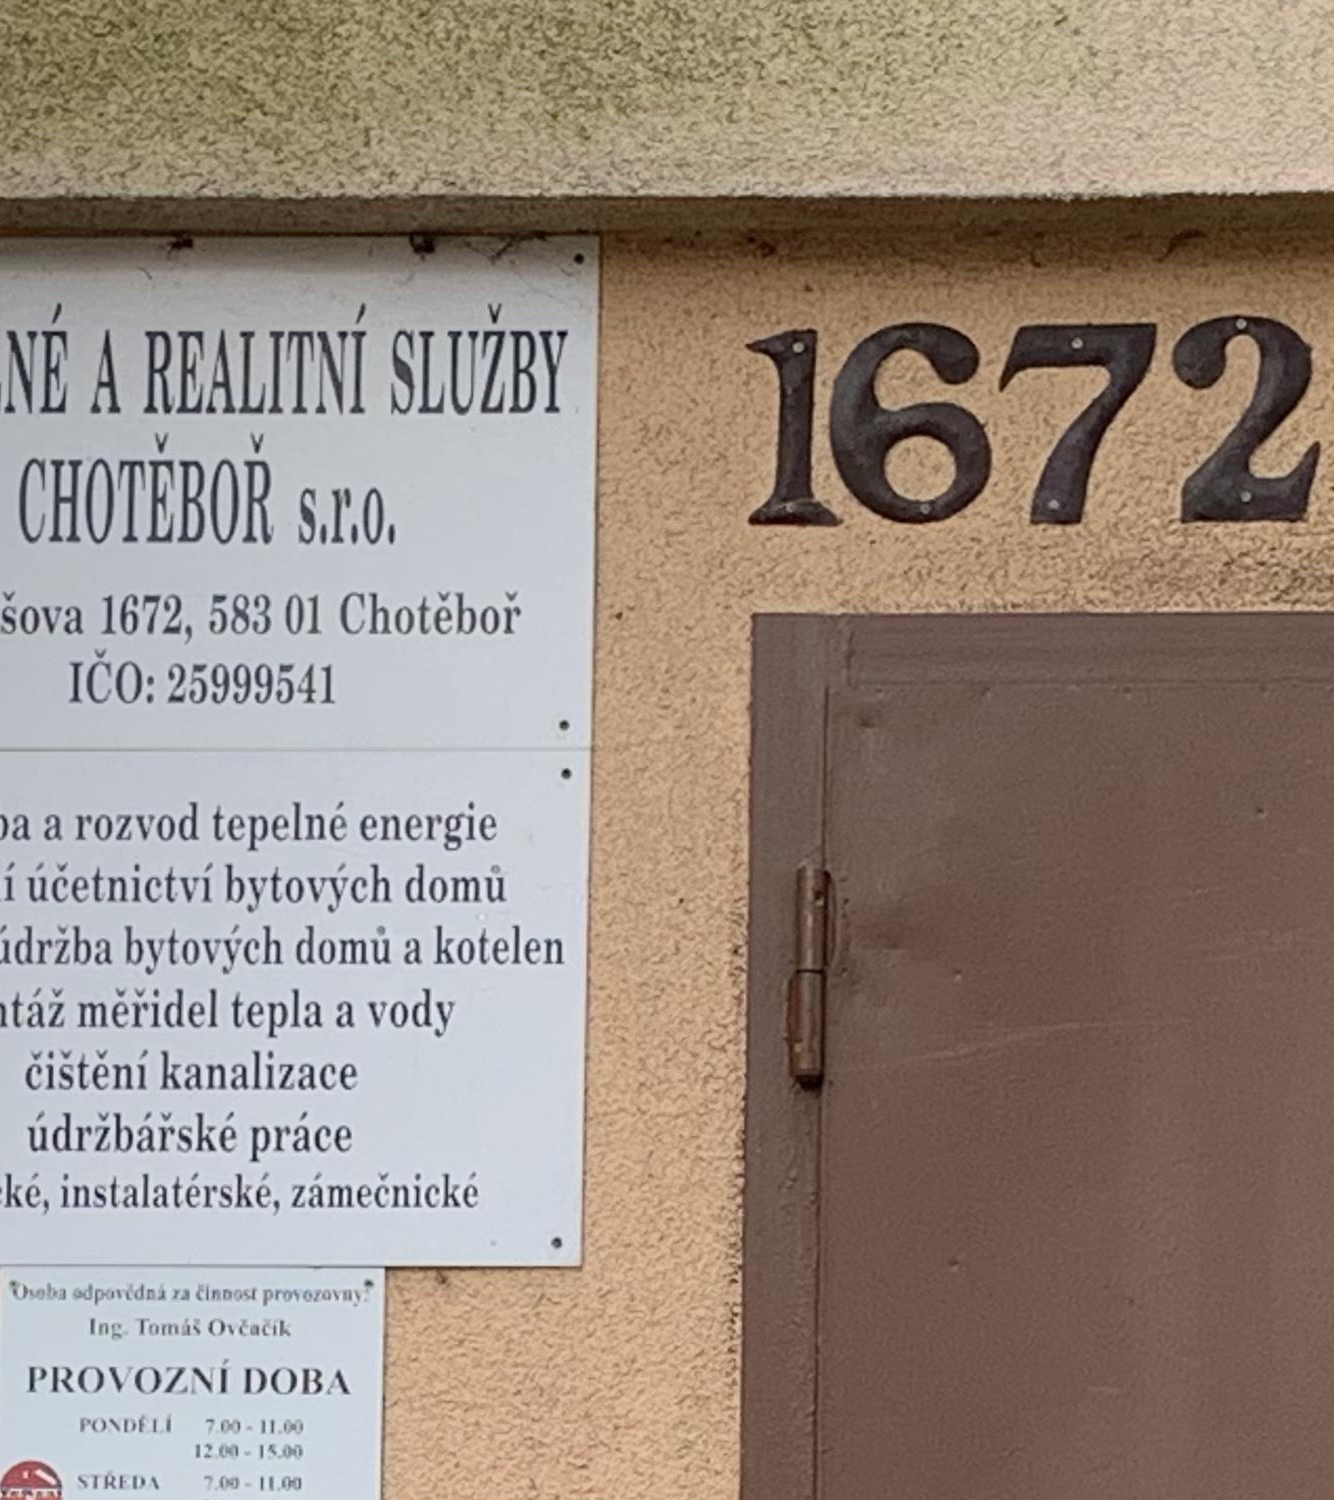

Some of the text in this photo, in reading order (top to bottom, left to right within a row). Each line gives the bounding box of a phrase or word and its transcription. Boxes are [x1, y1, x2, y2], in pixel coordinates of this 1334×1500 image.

[90, 329, 121, 414] A
[143, 303, 367, 414] REALITNÍ
[390, 303, 567, 415] SLUŽBY
[745, 315, 1321, 526] 1672
[19, 433, 395, 545] CHOTĚBOŘ s.r.o.
[102, 594, 192, 644] 1672,
[209, 594, 271, 634] 583
[285, 594, 321, 635] 01
[340, 592, 521, 635] Chotěboř
[70, 650, 335, 704] IČO: 25999541
[44, 814, 62, 840] a
[76, 802, 199, 841] rozvod
[212, 801, 347, 851] tepelné
[360, 802, 497, 851] energie
[27, 863, 213, 903] účetnictví
[225, 864, 391, 913] bytových
[404, 863, 506, 904] domů
[125, 925, 283, 975] bytových
[296, 925, 390, 966] domů
[404, 938, 422, 964] a
[434, 925, 564, 965] kotelen
[78, 988, 217, 1028] měřidel
[231, 989, 322, 1038] tepla
[336, 1001, 354, 1028] a
[368, 988, 454, 1037] vody
[25, 1050, 357, 1090] čištění kanalizace
[27, 1111, 352, 1162] údržbářské práce
[61, 1173, 280, 1213] instalatérské,
[292, 1172, 478, 1208] zámečnické
[14, 1282, 66, 1301] Osoba
[73, 1284, 166, 1306] odpovědná
[172, 1289, 190, 1301] za
[196, 1284, 257, 1301] činnost
[90, 1318, 127, 1340] Ing.
[136, 1318, 201, 1336] Tomáš
[28, 1359, 350, 1394] PROVOZNÍ DOBA
[80, 1415, 171, 1433] PONDĚLÍ
[205, 1418, 241, 1434] 7.00
[261, 1419, 303, 1435] 11.00
[195, 1443, 239, 1458] 12.00
[259, 1444, 303, 1459] 15.00
[78, 1471, 159, 1490] STŘEDA
[204, 1475, 240, 1490] 7.00
[260, 1476, 302, 1491] 11.00
